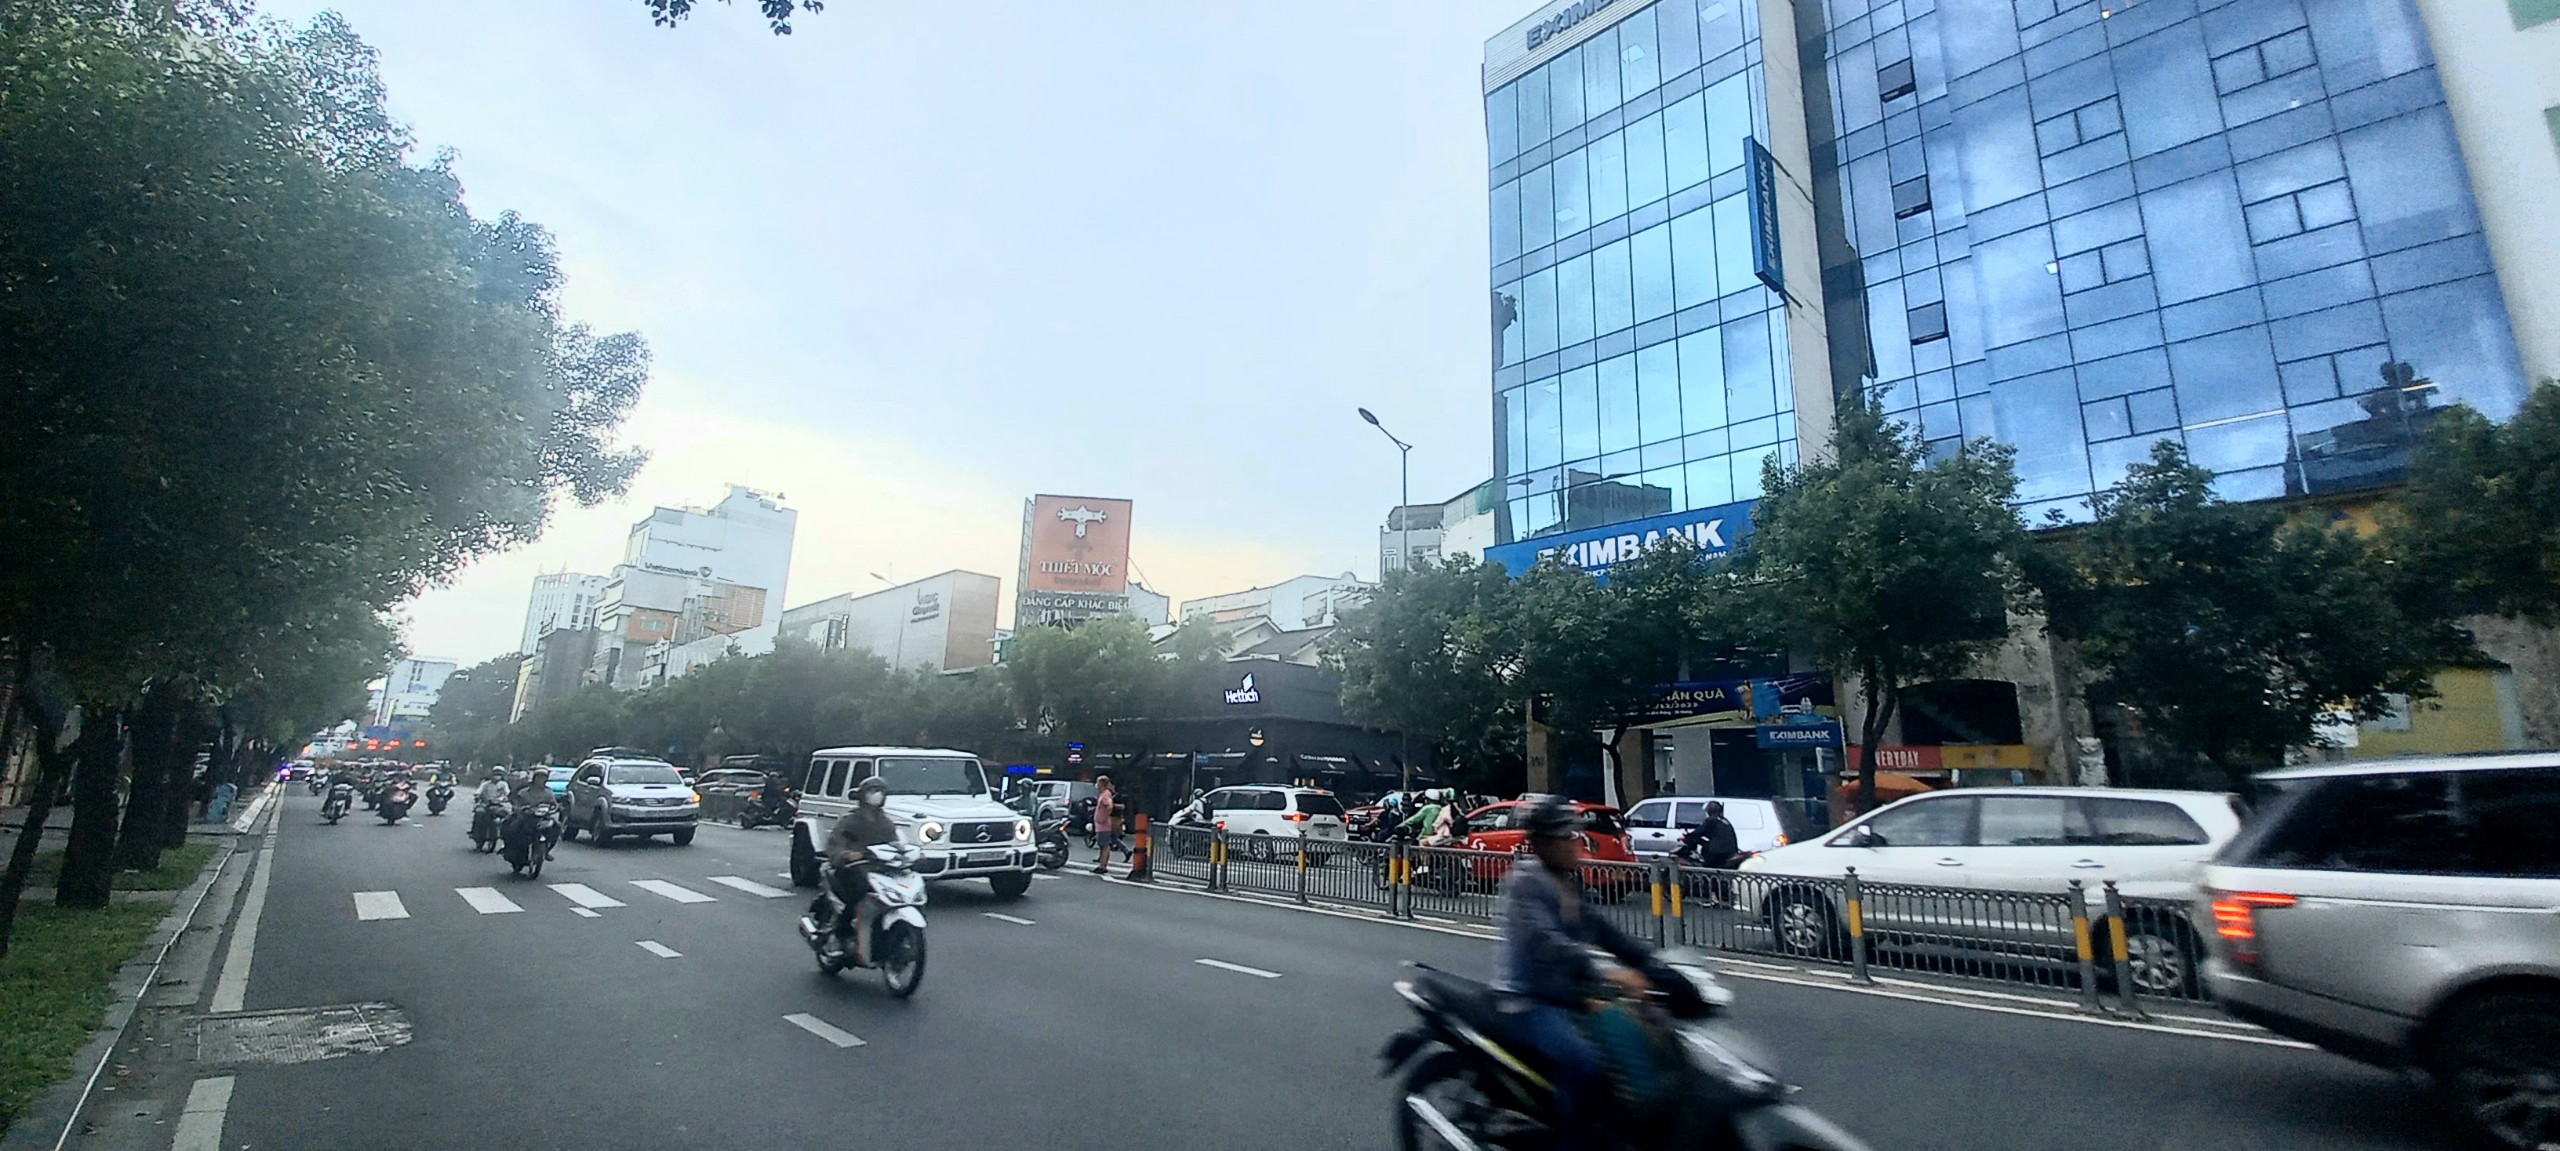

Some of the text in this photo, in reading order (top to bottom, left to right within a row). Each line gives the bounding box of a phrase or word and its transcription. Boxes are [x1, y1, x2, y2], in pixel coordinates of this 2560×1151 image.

[1759, 157, 1776, 270] EXIMBANK
[1694, 687, 1725, 702] QUÀ
[1875, 750, 1919, 767] VERYDAY
